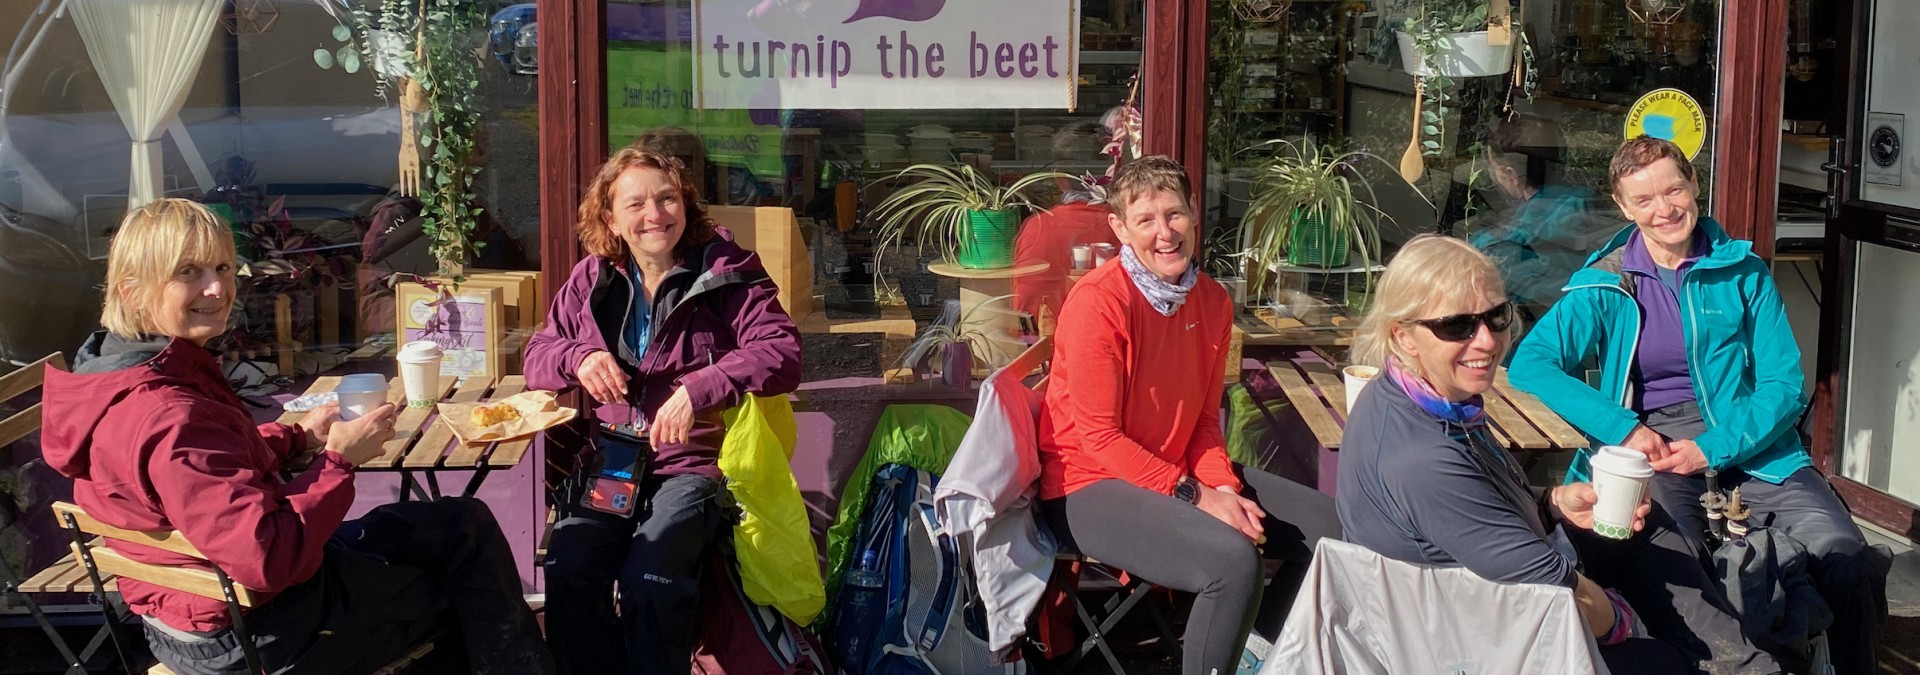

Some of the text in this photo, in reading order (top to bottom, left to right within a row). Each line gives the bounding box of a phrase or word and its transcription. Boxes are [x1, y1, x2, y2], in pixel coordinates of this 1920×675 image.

[714, 30, 1059, 89] turnip the beet
[1629, 92, 1702, 133] PLEASE WEAR A FACE MASK
